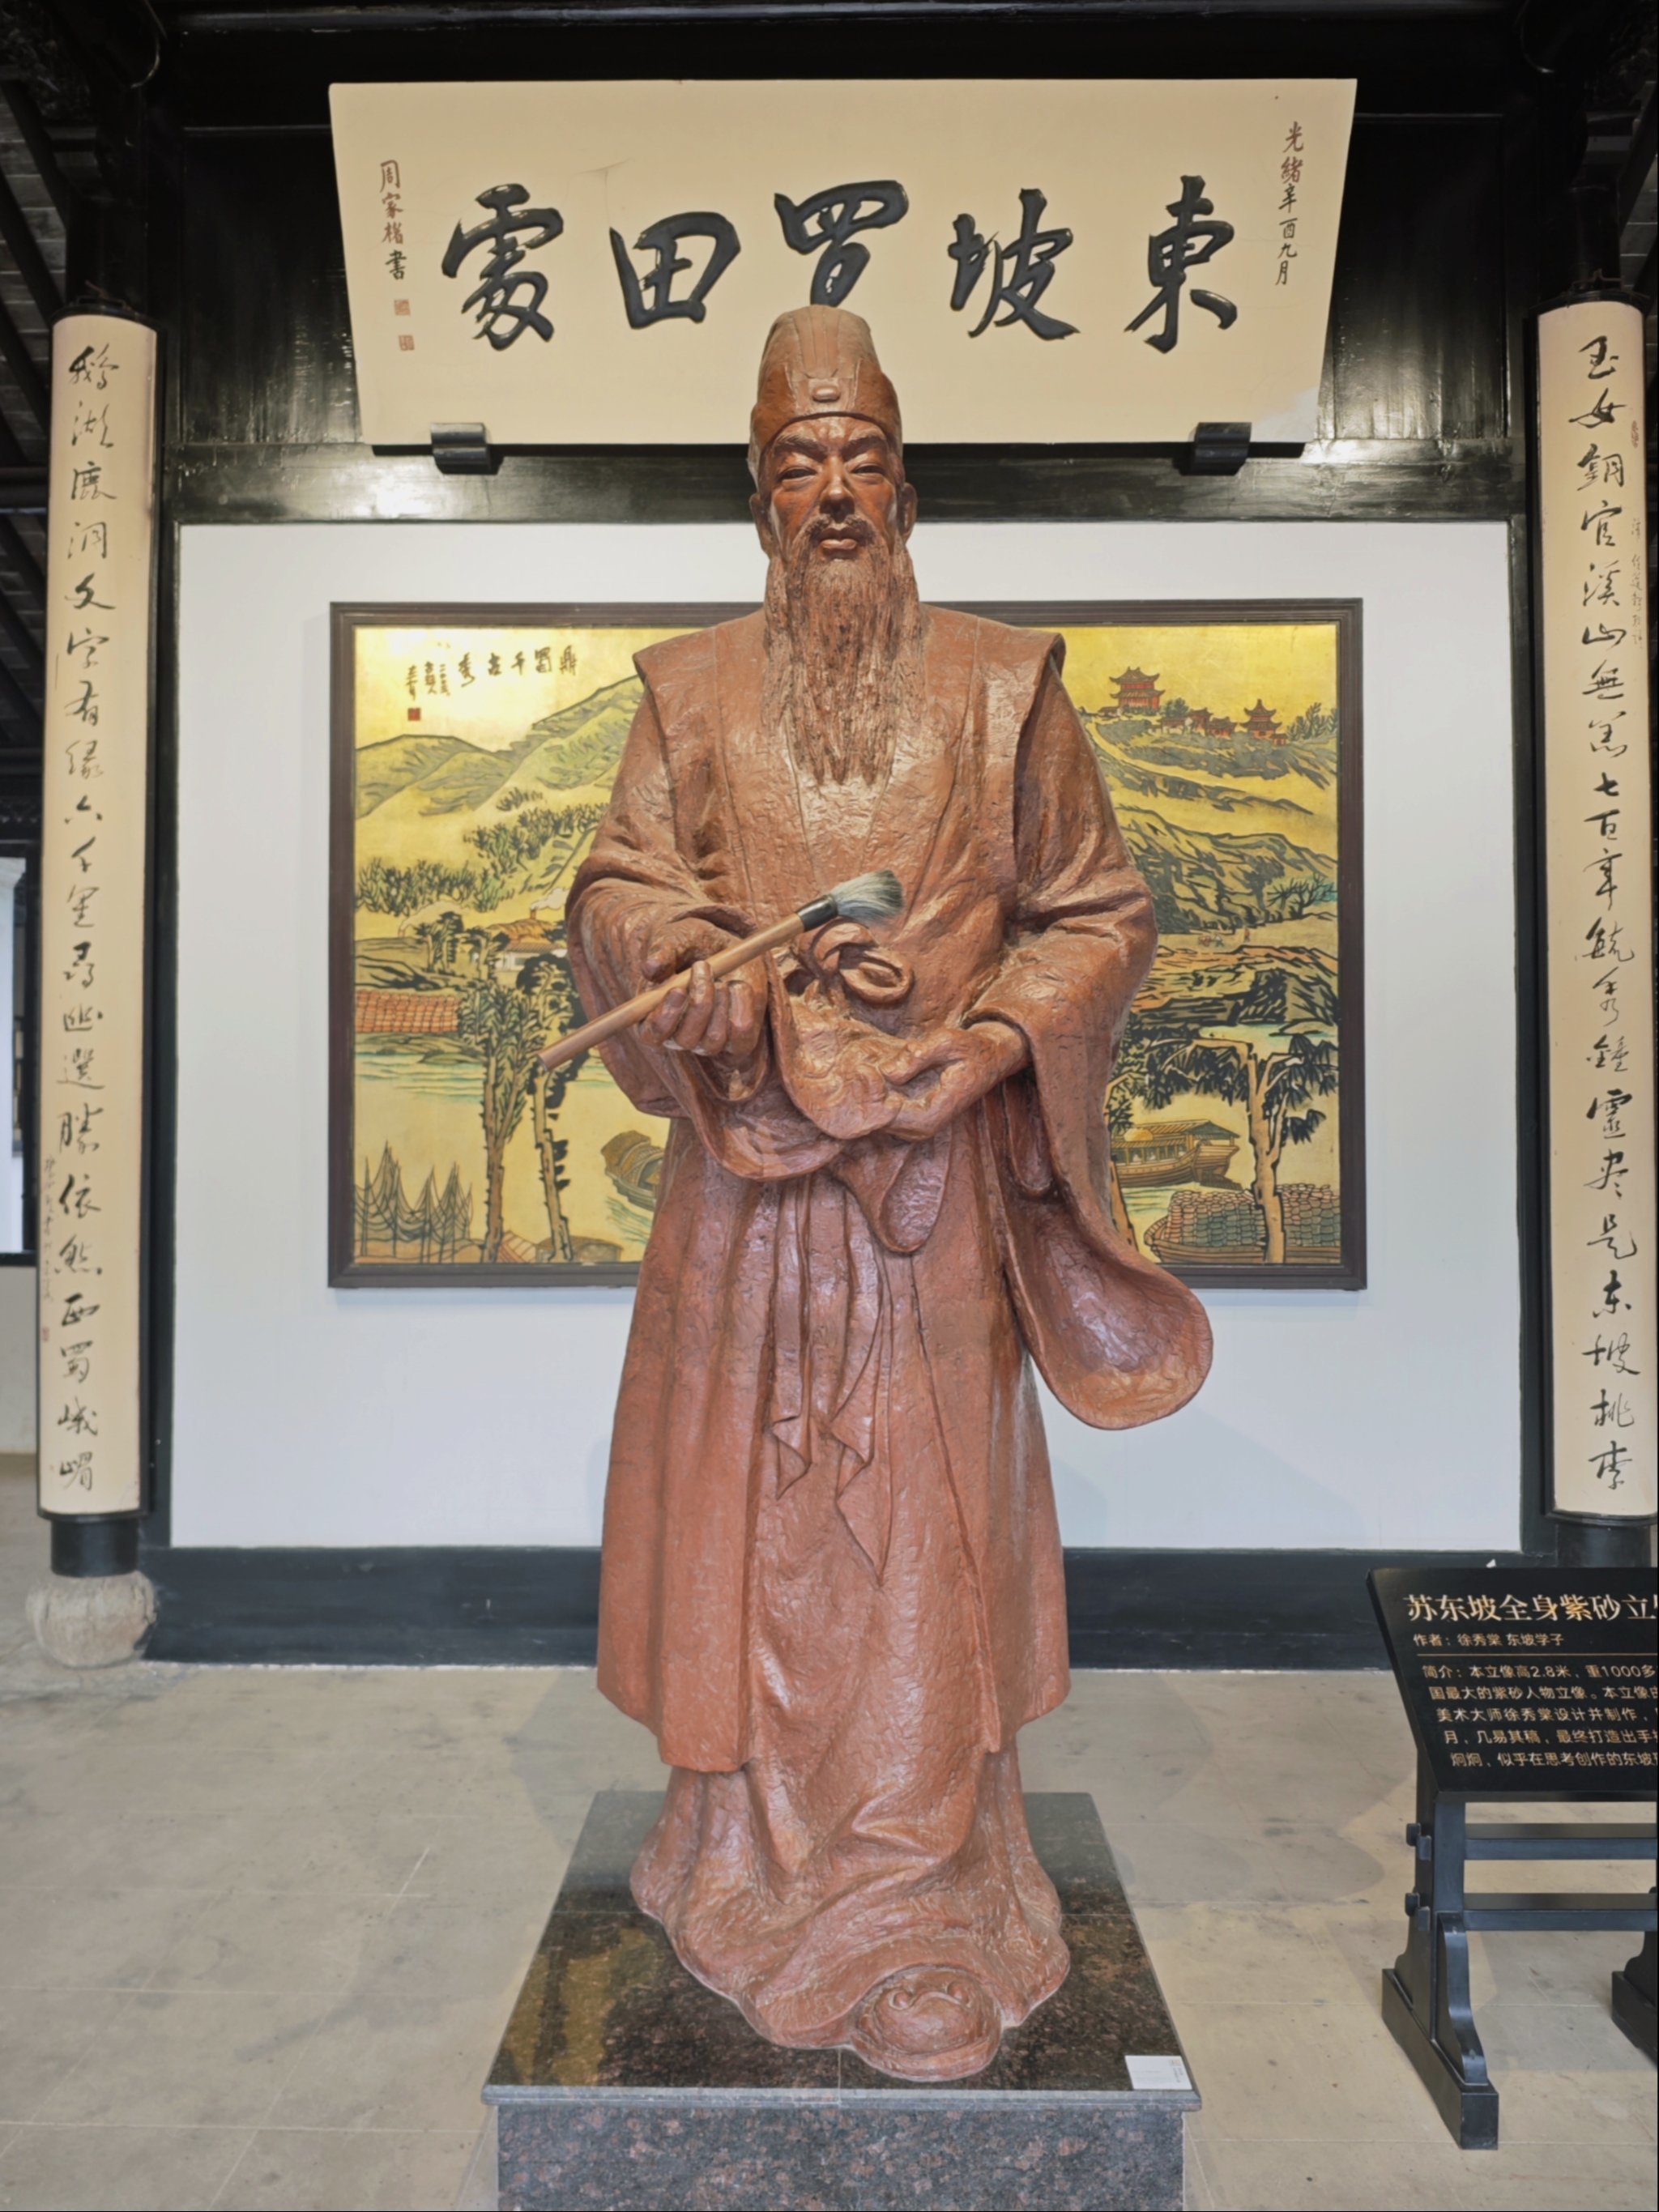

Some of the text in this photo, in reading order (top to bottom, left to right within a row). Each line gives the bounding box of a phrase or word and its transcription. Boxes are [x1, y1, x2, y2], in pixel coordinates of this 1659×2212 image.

[1403, 1594, 1657, 1622] 苏东坡全身紫砂立
[1436, 1707, 1657, 1723] 美术大师徐秀棠设计并制作，
